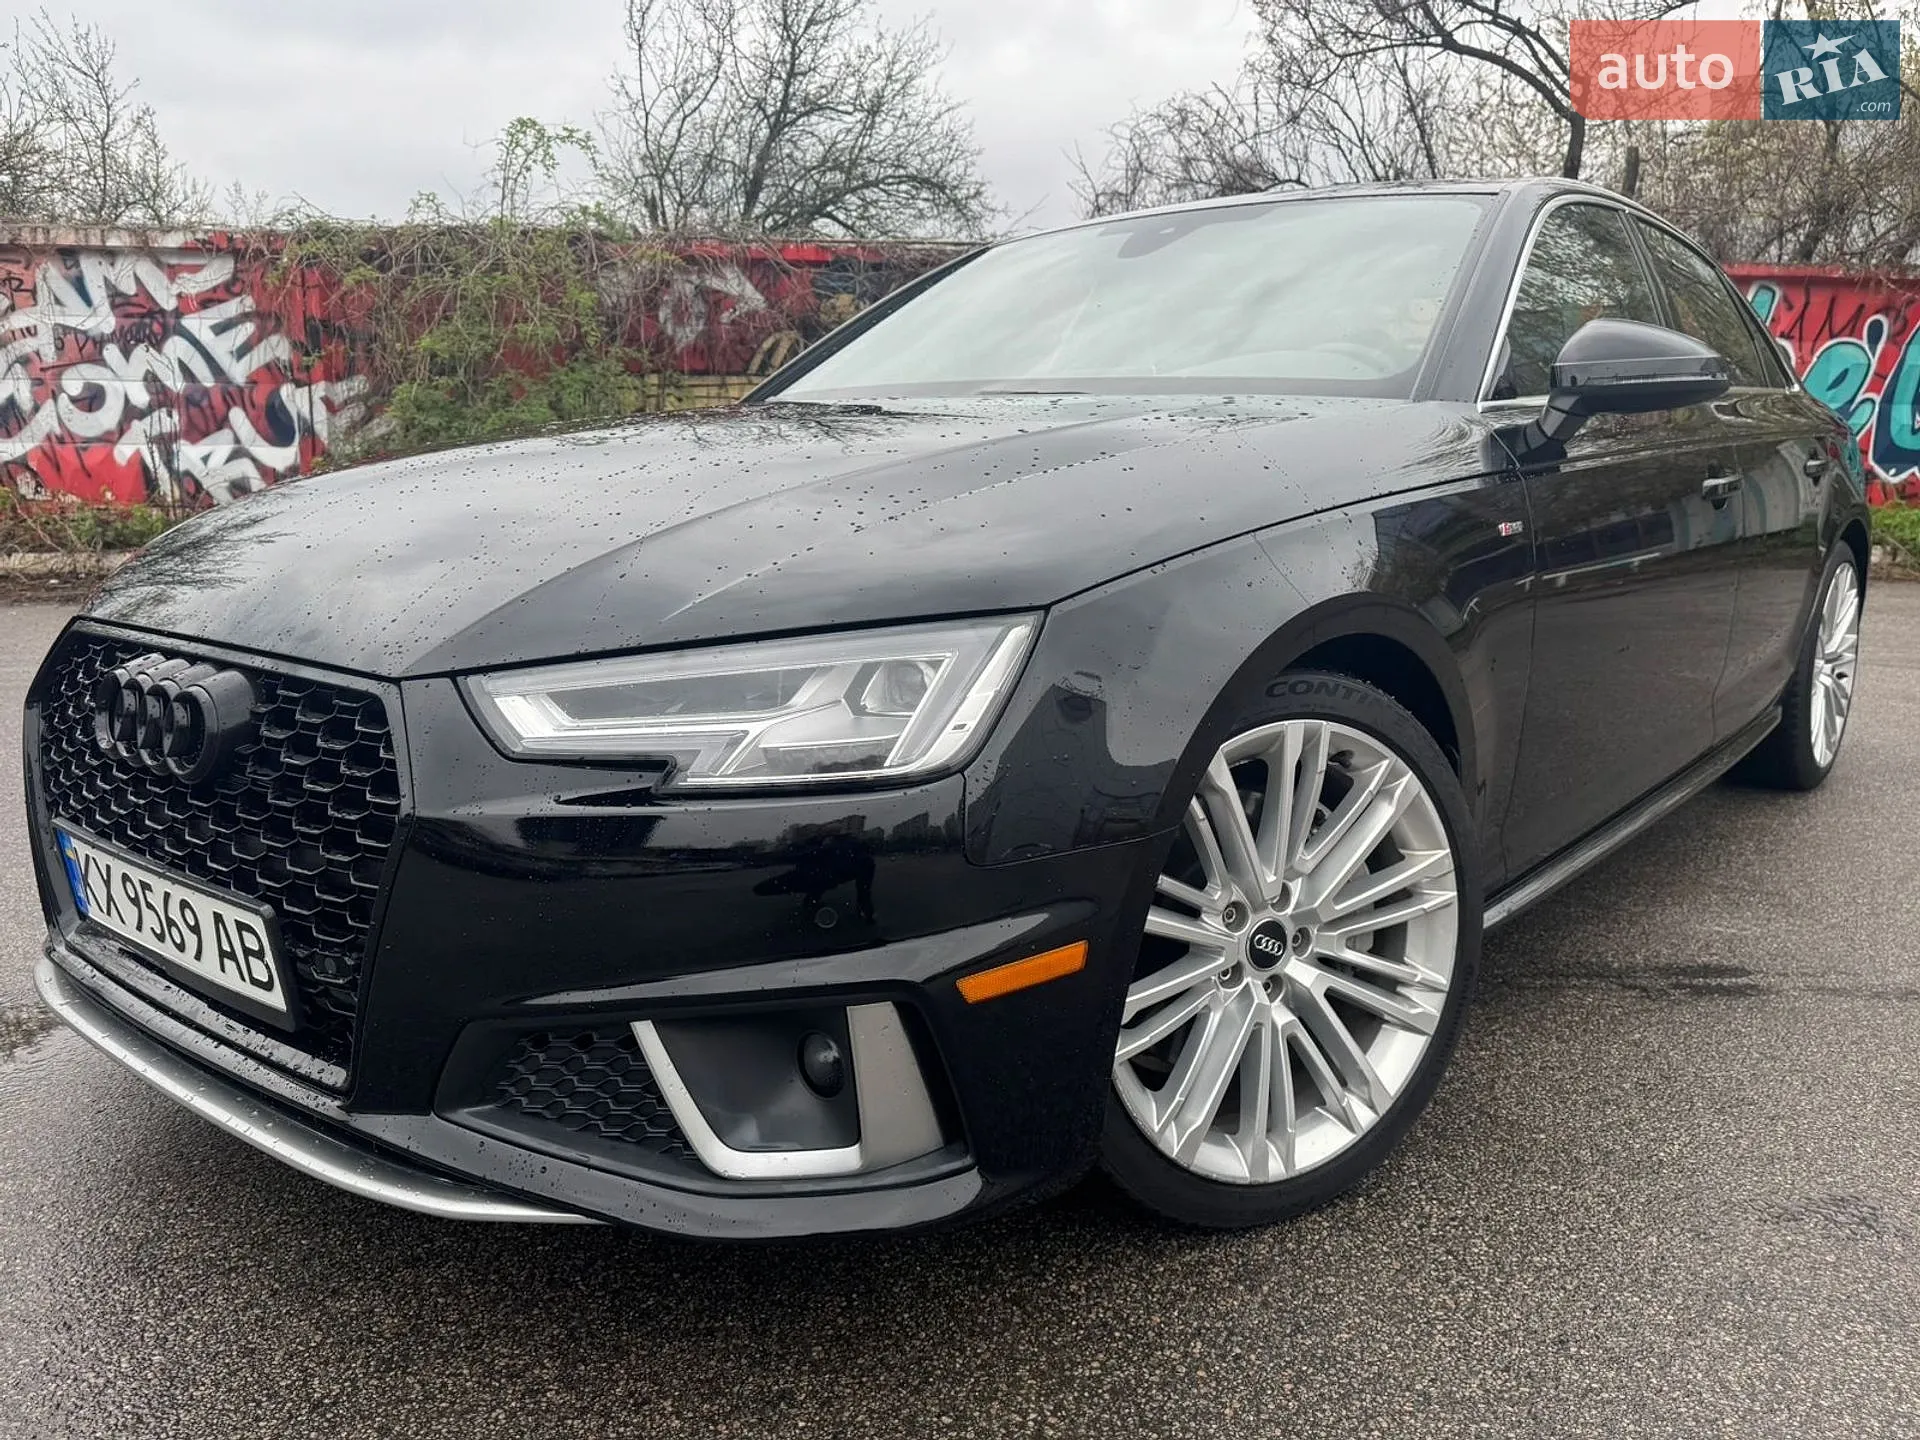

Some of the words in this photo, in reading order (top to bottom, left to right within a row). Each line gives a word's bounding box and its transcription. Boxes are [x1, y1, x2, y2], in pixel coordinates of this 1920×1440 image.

[1265, 680, 1372, 705] CONTI
[121, 872, 203, 962] 9569
[212, 910, 275, 993] AB
